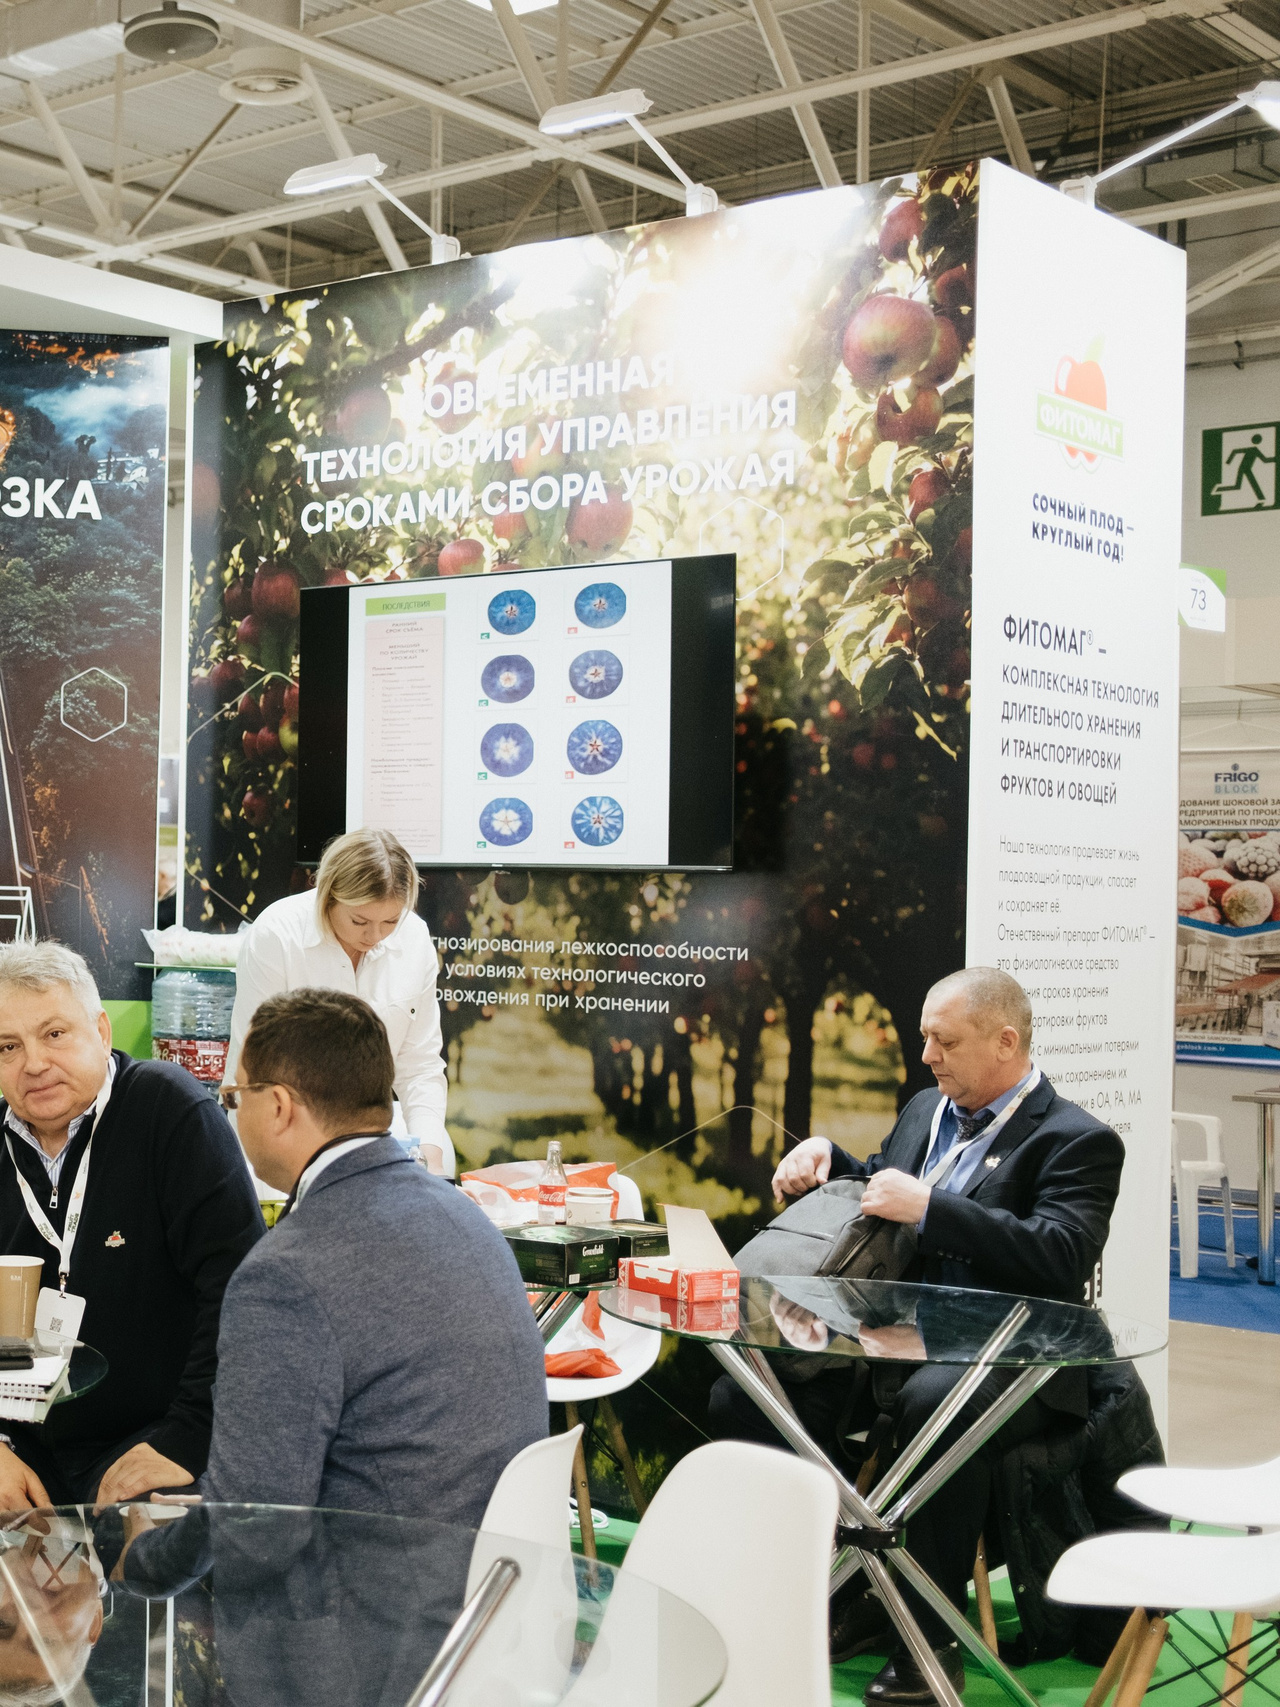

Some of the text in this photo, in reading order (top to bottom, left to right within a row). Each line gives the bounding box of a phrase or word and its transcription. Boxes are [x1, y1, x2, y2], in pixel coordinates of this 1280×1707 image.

[424, 354, 674, 418] ОВРЕМЕННАЯ
[1040, 402, 1120, 450] ФИТОМАГ
[301, 391, 797, 485] ТЕХНОЛОГИЯ УПРАВЛЕНИЯ
[300, 450, 796, 535] СРОКАМИ СБОРА УРОЖАЯ
[1033, 493, 1123, 537] СОЧНЫЙ ПЛОД
[1032, 521, 1123, 563] КРУГЛЫЙ ГОД!
[382, 600, 431, 610] ПОСЛЕДСТВИЯ
[1190, 588, 1207, 611] 73
[1002, 664, 1159, 708] КОМПЛЕКСНАЯ ТЕХНОЛОГИЯ
[1001, 701, 1141, 739] ДЛИТЕЛЬНОГО ХРАНЕНИЯ
[1002, 737, 1121, 771] И ТРАНСПОРТИРОВКИ
[1214, 772, 1259, 782] FRIGO
[1001, 774, 1117, 806] ФРУКТОВ И ОВОЩЕЙ
[1215, 784, 1258, 794] BLOCK
[1222, 798, 1268, 806] ШОКОВОЙ
[999, 835, 1139, 862] Наша технология продлевает жизнь
[999, 869, 1136, 890] плодоовощной продукции, спасает
[1006, 898, 1061, 917] сохраняет её.
[997, 923, 1060, 941] Отечественный
[1063, 931, 1099, 947] препарат
[560, 939, 749, 961] лежкоспособности
[445, 961, 706, 988] условиях технологического
[997, 953, 1119, 975] это физиологическое средство
[535, 991, 569, 1011] при
[575, 994, 670, 1014] хранении
[1043, 987, 1108, 1003] сроков хранения
[1076, 1010, 1107, 1031] фруктов
[1044, 1040, 1139, 1055] минимальными потерями
[1065, 1070, 1116, 1086] сохранением
[1097, 1091, 1112, 1110] ОА,
[1115, 1090, 1125, 1108] РА,
[1129, 1089, 1142, 1105] МА
